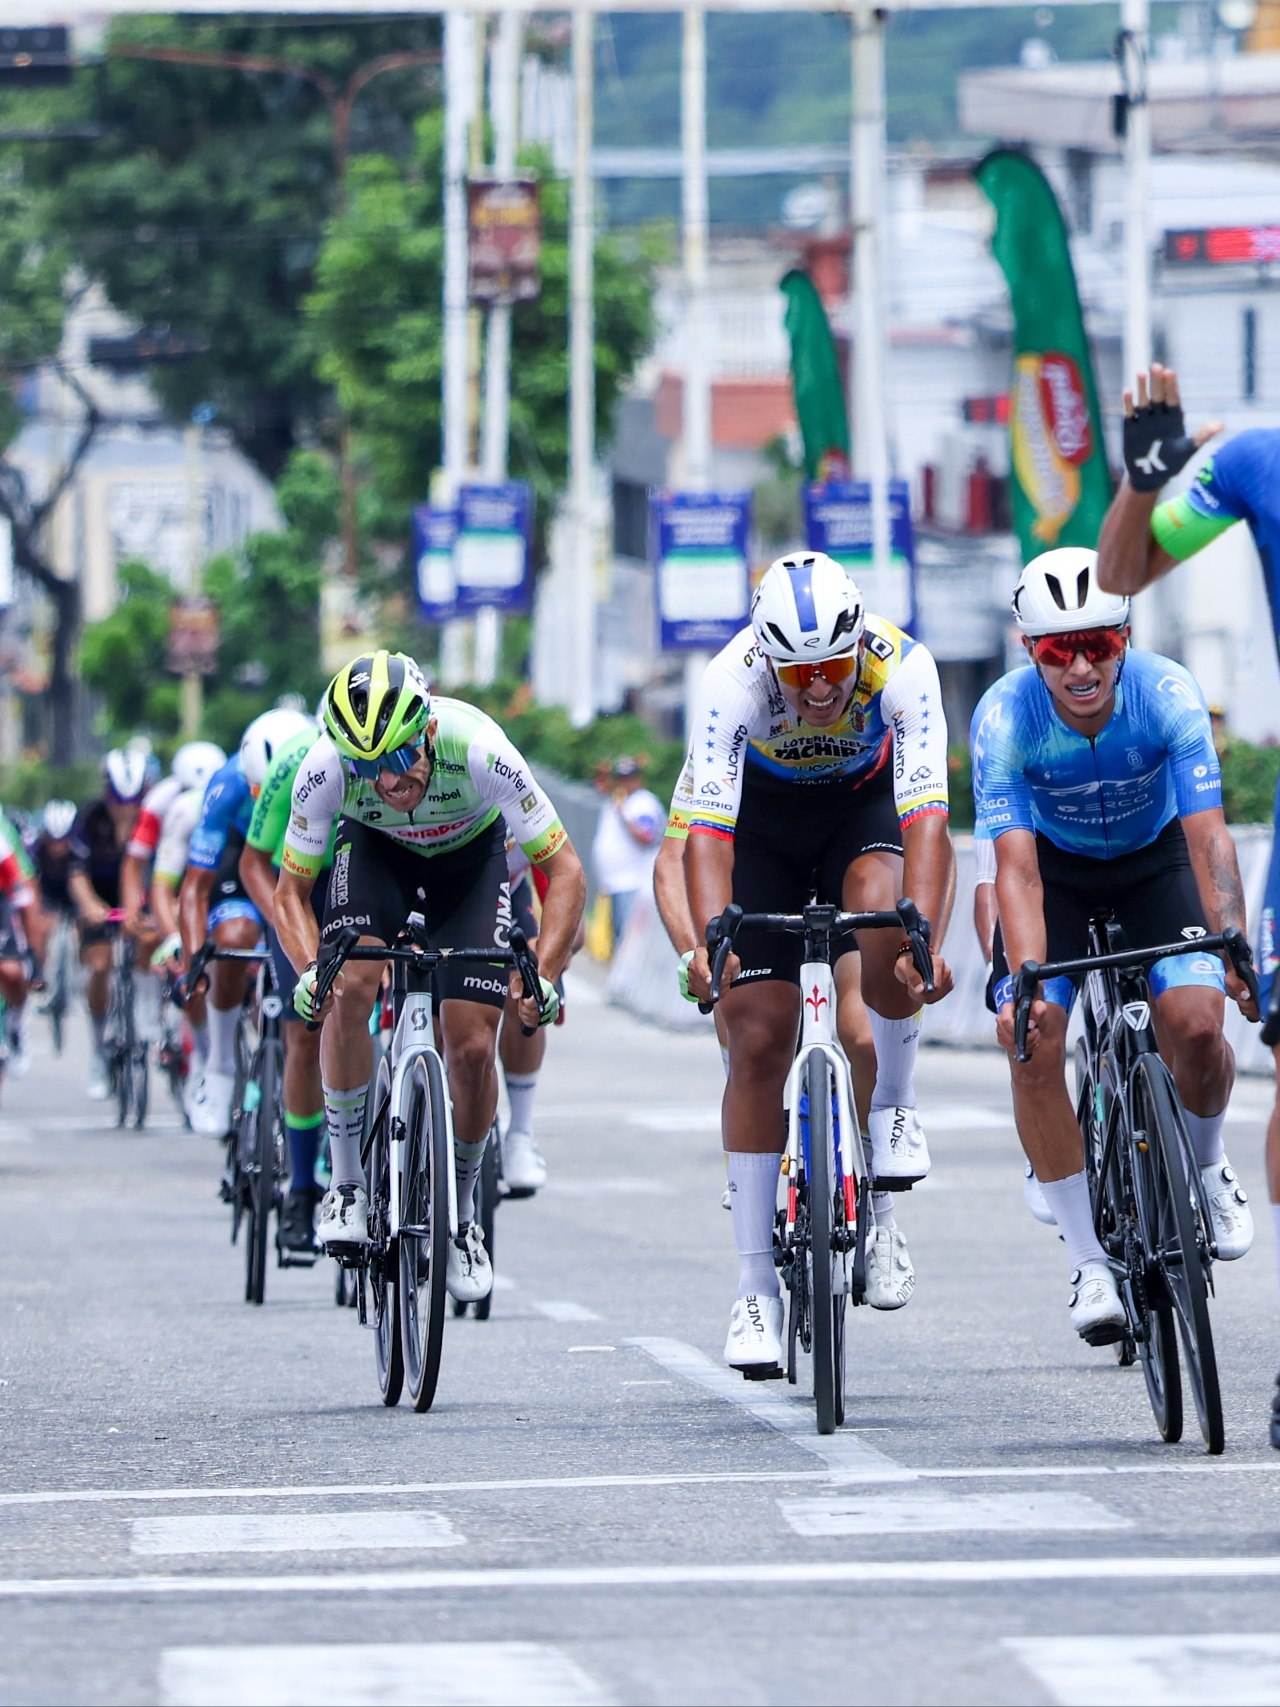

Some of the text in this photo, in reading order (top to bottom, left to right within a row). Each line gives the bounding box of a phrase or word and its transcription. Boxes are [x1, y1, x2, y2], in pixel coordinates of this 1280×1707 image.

[784, 735, 836, 748] LOTERÍA
[891, 709, 905, 780] ALICANTO
[722, 724, 748, 791] ALICANTO
[295, 769, 327, 802] tavfer
[494, 756, 527, 792] tavfer
[692, 799, 733, 811] SORIO
[896, 782, 944, 800] OSORIO
[1085, 793, 1149, 813] ERCO
[321, 914, 371, 939] mobel
[493, 881, 512, 949] CIMA
[463, 976, 509, 997] mobe
[896, 1269, 915, 1303] nimb
